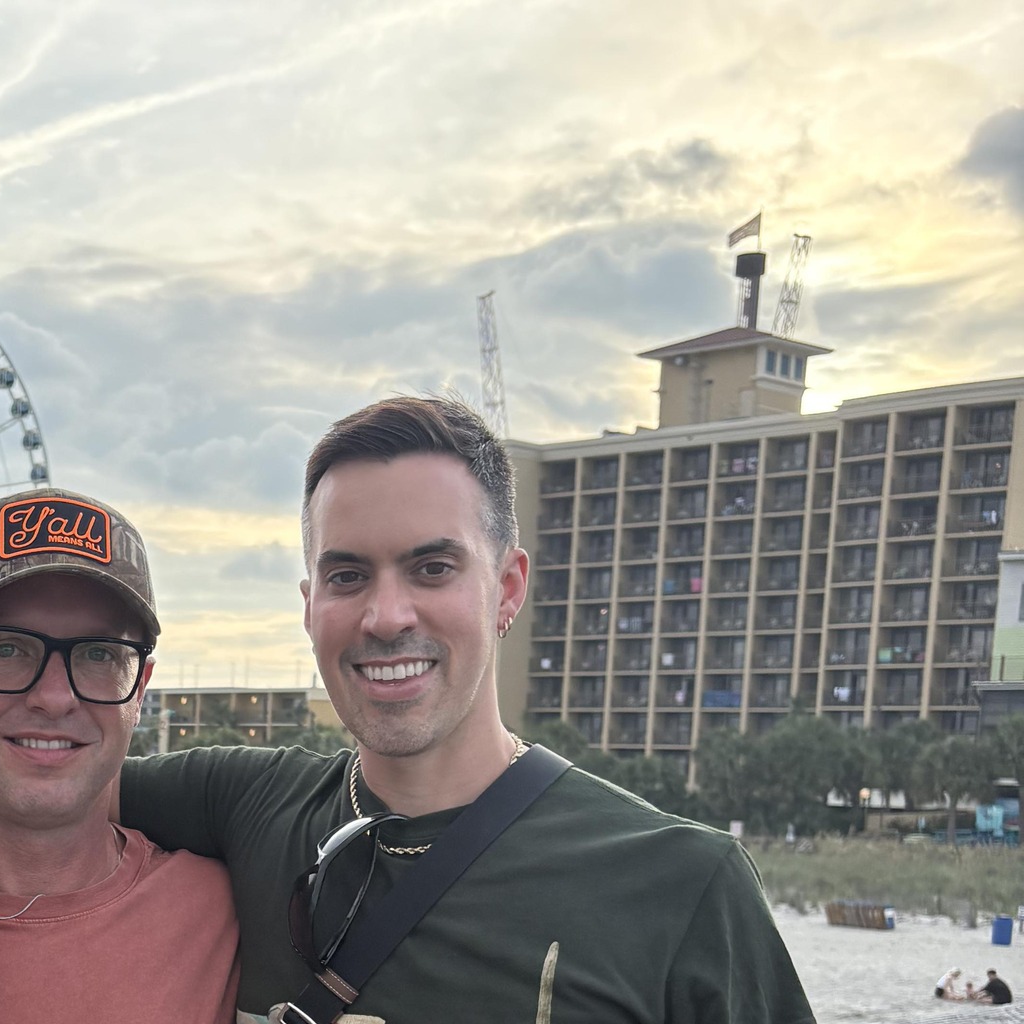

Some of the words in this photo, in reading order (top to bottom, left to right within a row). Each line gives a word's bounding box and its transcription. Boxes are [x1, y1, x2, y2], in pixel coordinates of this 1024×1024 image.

[8, 505, 103, 549] Y'all
[48, 534, 84, 547] MEANS
[85, 540, 104, 554] ALL
